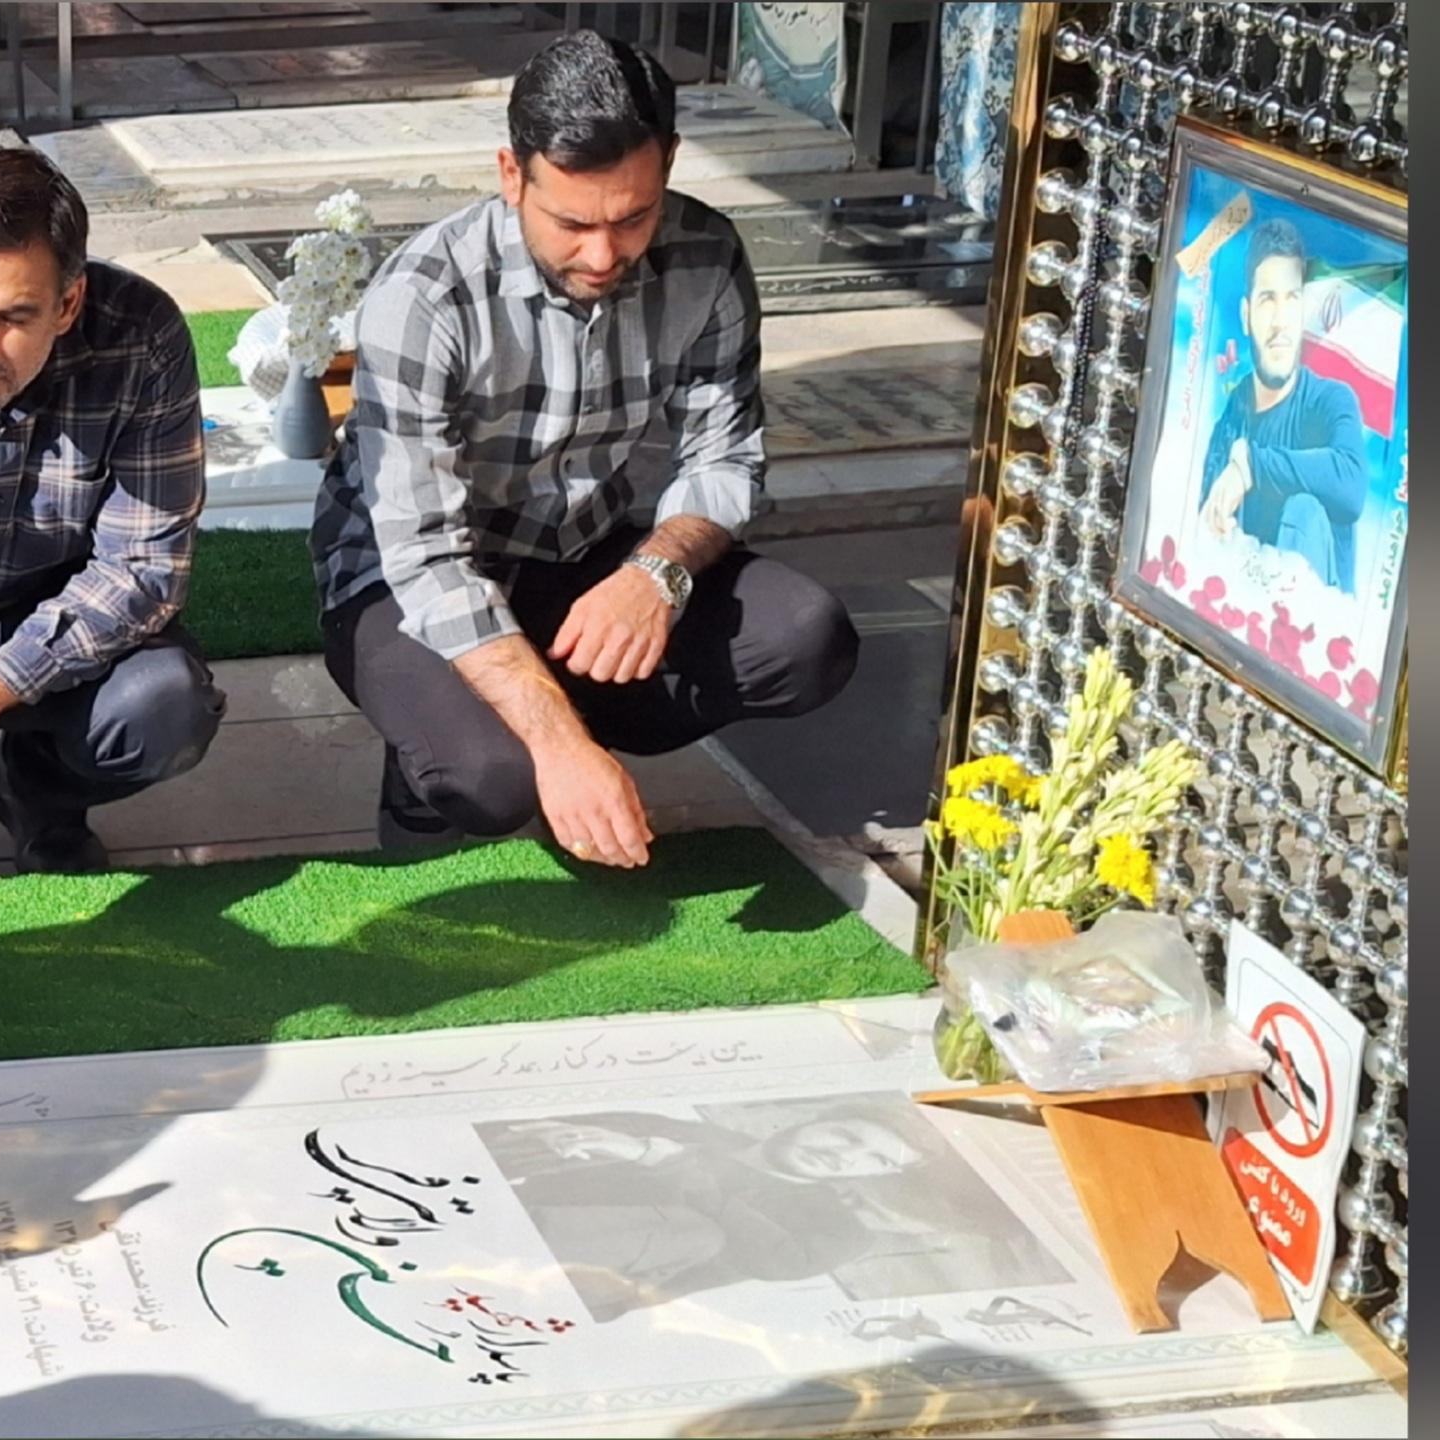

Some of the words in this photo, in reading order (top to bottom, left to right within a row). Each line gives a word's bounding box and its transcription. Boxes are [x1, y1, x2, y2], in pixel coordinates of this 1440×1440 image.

[550, 1032, 606, 1072] کنار
[595, 1053, 618, 1069] در
[340, 1061, 394, 1099] زدیم
[1239, 1154, 1272, 1185] کفش
[1270, 1173, 1281, 1202] با
[1248, 1194, 1292, 1248] ممنوع
[1280, 1187, 1307, 1228] ورود
